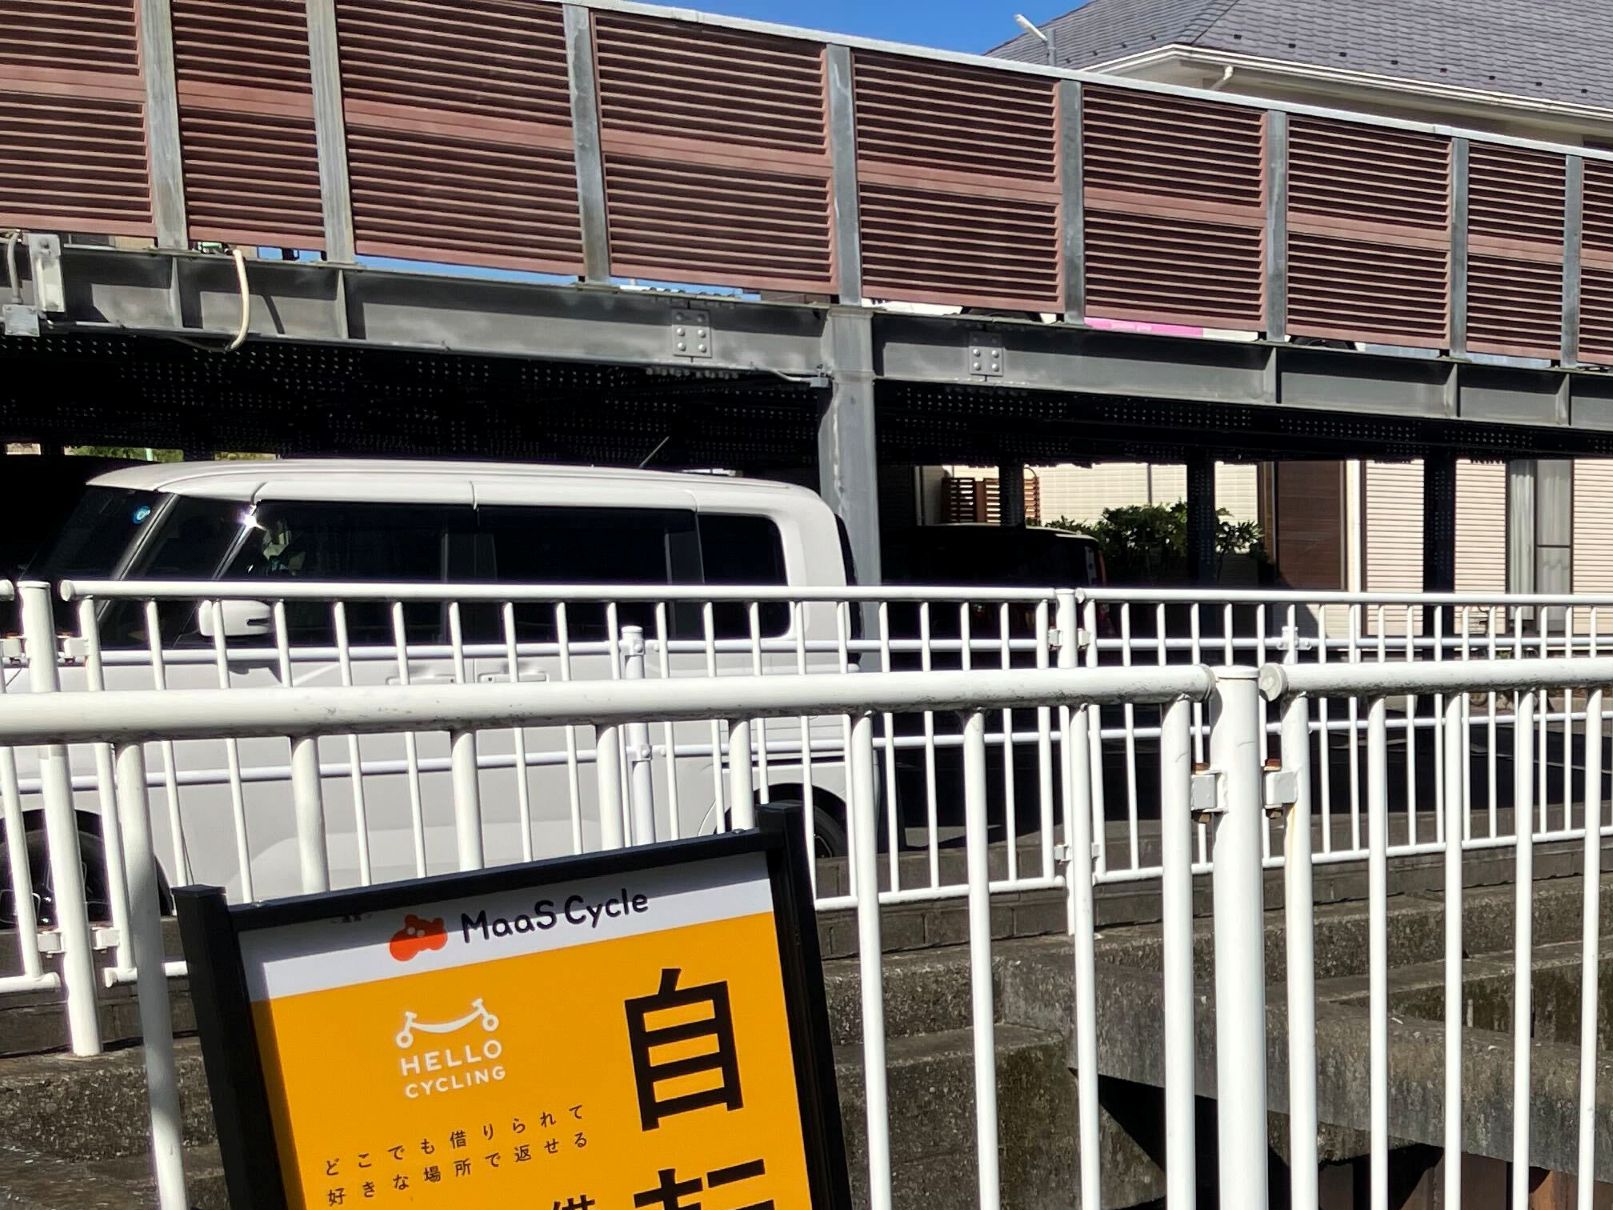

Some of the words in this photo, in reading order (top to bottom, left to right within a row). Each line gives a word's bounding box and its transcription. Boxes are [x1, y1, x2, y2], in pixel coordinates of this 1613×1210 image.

[460, 900, 557, 944] MaaS
[564, 888, 649, 931] Cycle
[401, 1039, 503, 1077] HELLO
[405, 1065, 507, 1099] CYCLING
[325, 1104, 584, 1177] どこでも借りられて
[327, 1131, 588, 1207] 好きな場所で返せる
